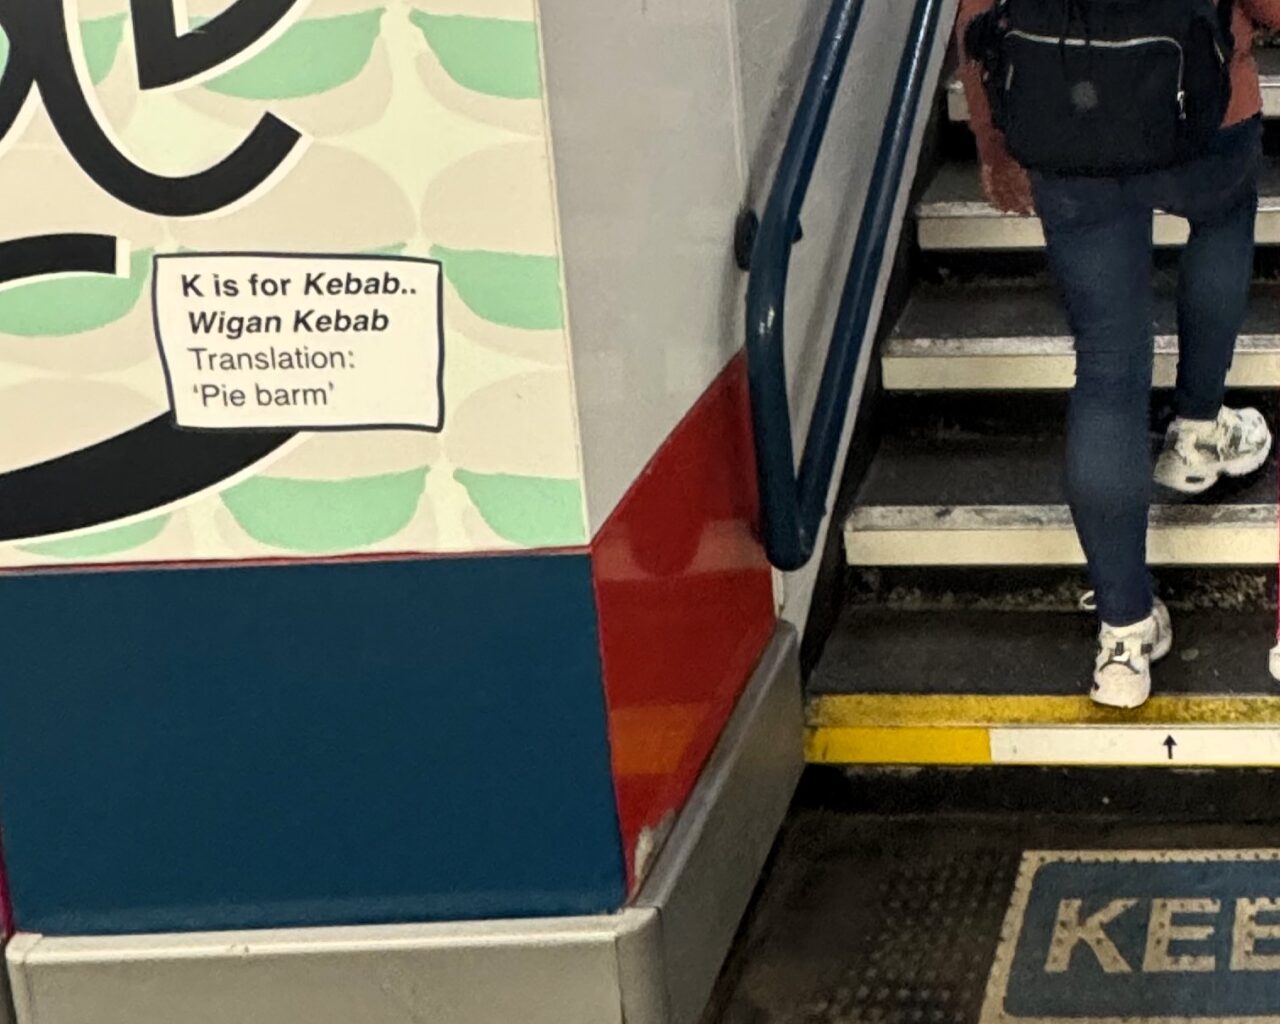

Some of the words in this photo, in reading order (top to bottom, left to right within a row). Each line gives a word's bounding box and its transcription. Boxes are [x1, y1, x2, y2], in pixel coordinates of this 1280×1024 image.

[181, 274, 203, 297] K
[214, 274, 239, 297] is
[249, 273, 291, 296] for
[304, 272, 417, 295] Kebab..
[189, 311, 282, 340] Wigan
[293, 309, 389, 333] Kebab
[188, 347, 355, 370] Translation:
